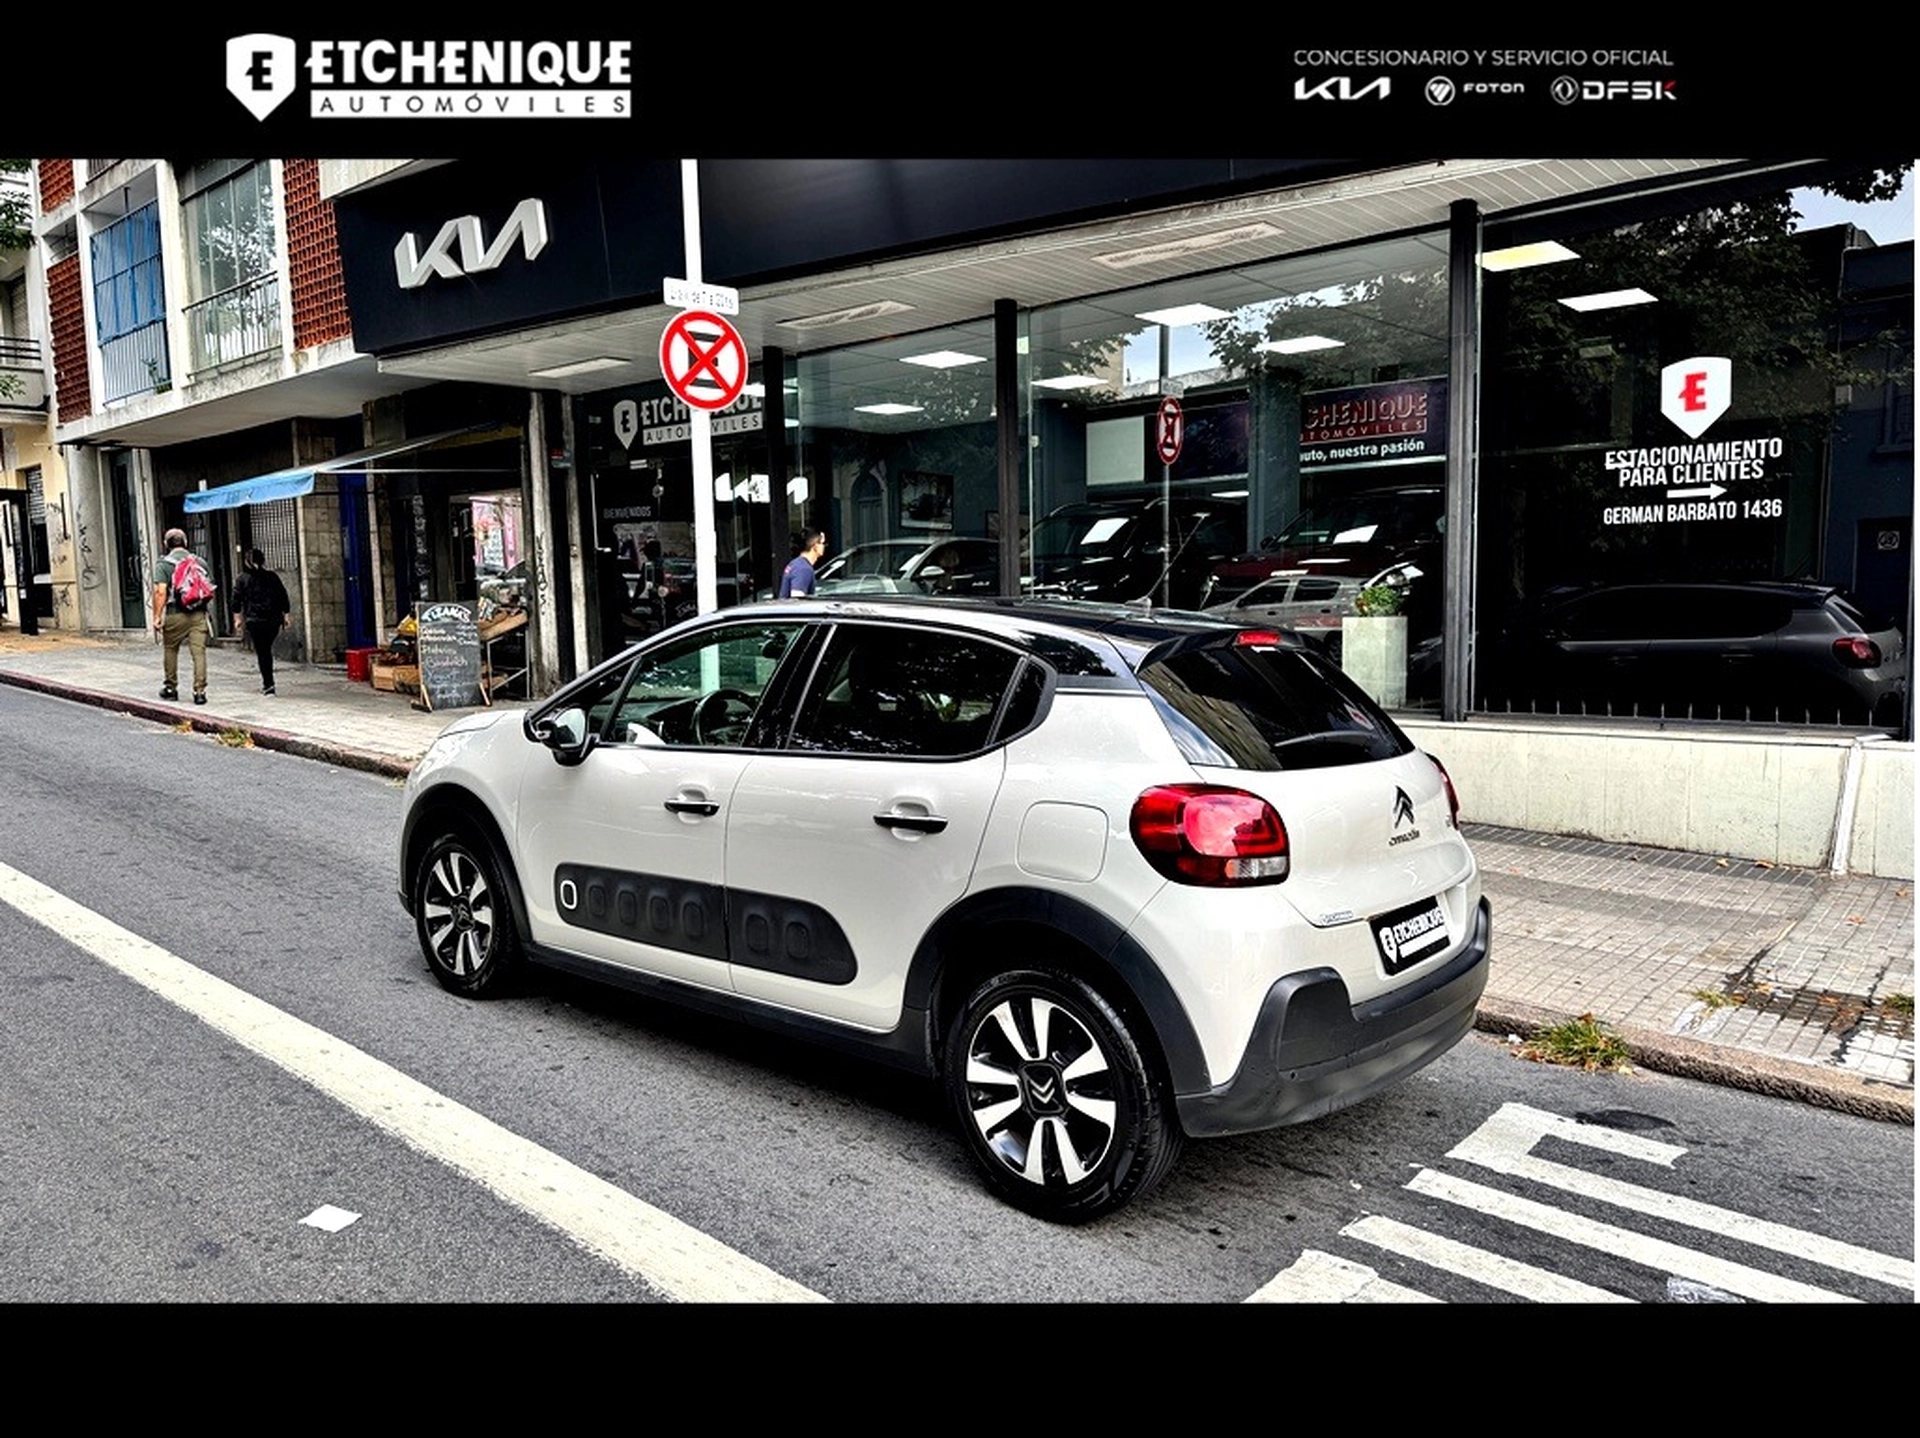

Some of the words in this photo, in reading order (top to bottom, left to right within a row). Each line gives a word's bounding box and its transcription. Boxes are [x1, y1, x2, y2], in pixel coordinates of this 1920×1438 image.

[394, 198, 548, 289] KIA
[1330, 444, 1378, 460] nuestra
[1381, 438, 1425, 457] pasión
[1605, 437, 1783, 470] ESTACIONAMIENTO
[1618, 466, 1668, 488] PARA
[1672, 459, 1765, 484] CLIENTES
[1603, 504, 1664, 525] GERMAN
[1667, 501, 1737, 522] BARBATO
[1742, 499, 1783, 519] 1436
